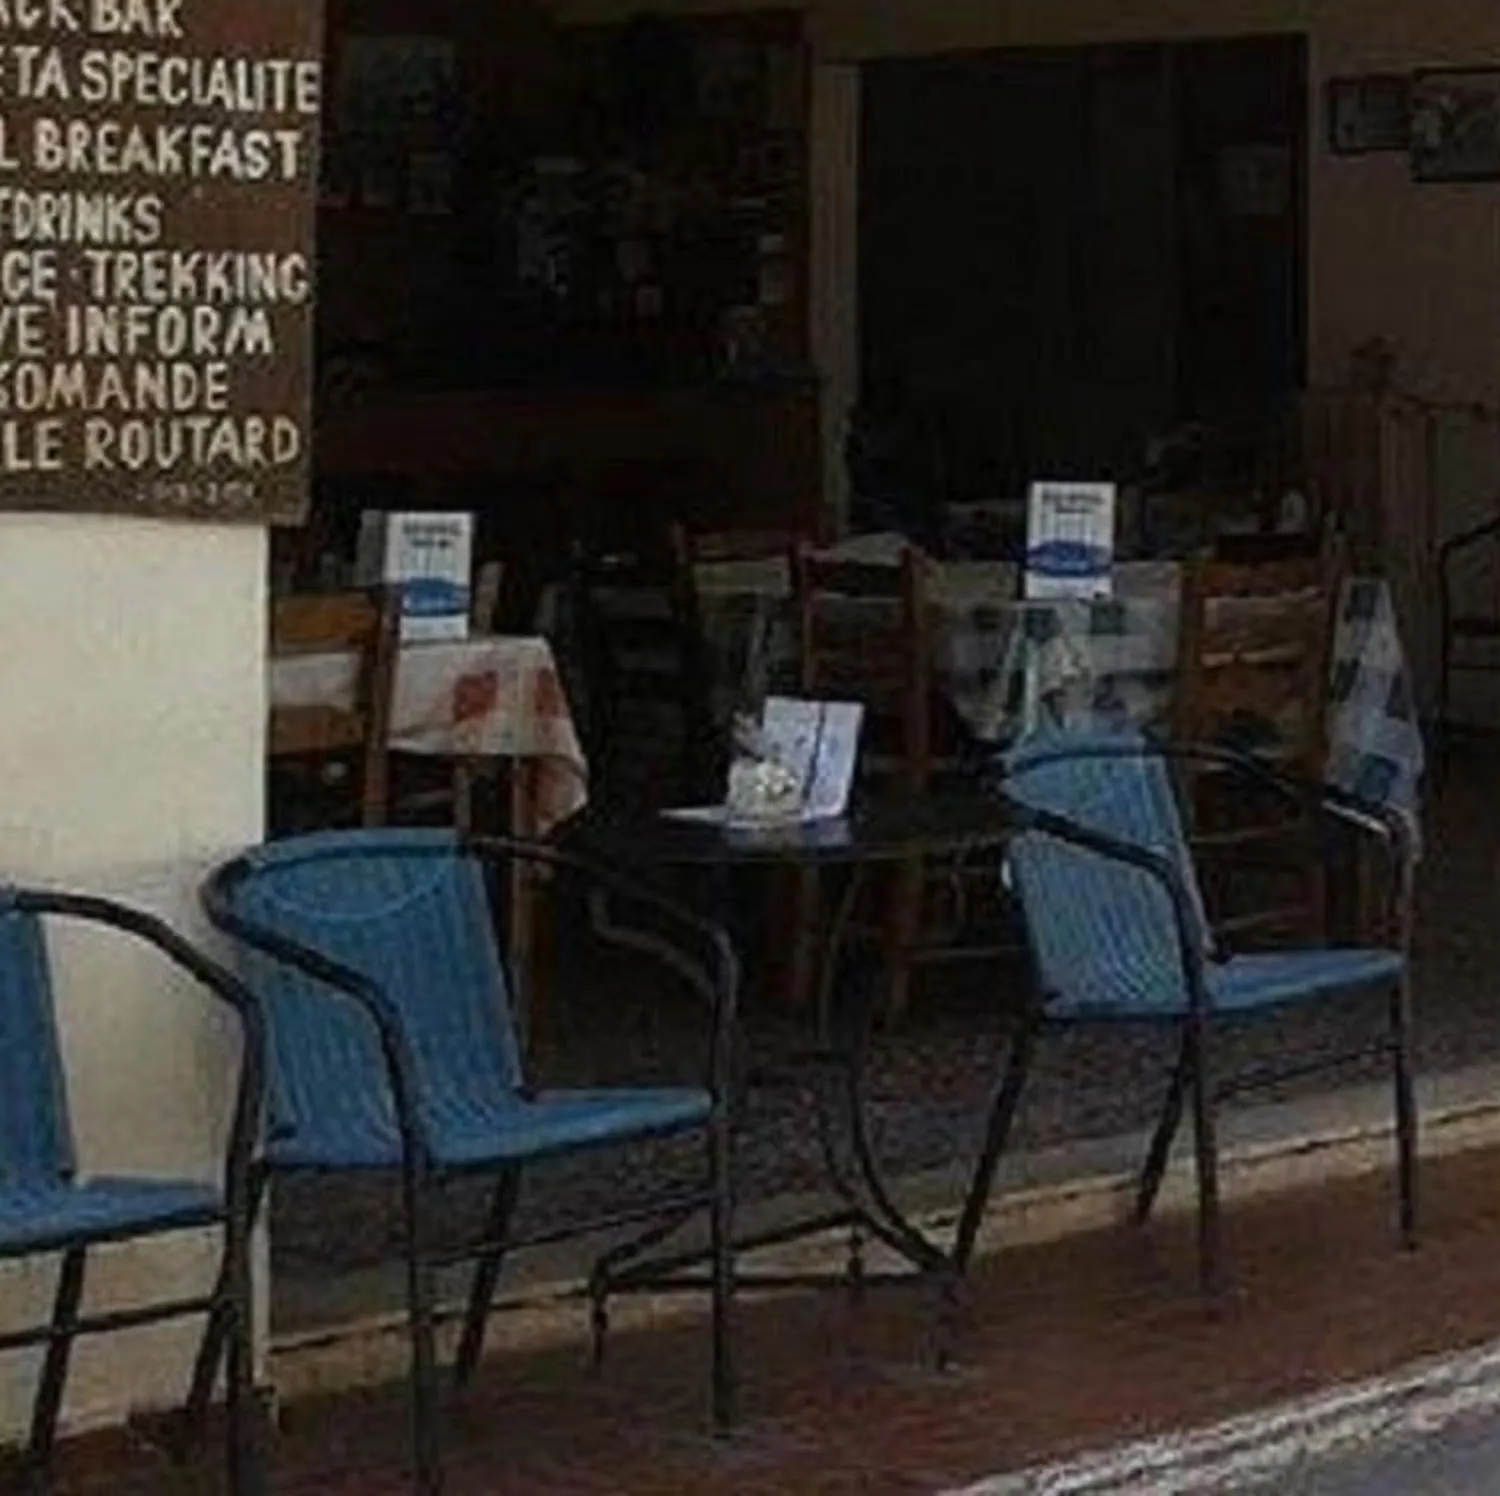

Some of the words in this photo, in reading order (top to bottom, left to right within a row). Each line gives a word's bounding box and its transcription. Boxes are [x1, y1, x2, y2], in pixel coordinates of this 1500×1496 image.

[80, 49, 322, 112] SPECIALITE
[33, 117, 302, 180] BREAKFAST
[13, 189, 164, 244] DRINKS
[84, 249, 310, 304] TREKKING
[66, 304, 273, 357] INFORM
[4, 417, 64, 471] LE
[84, 415, 300, 472] ROUTARD
